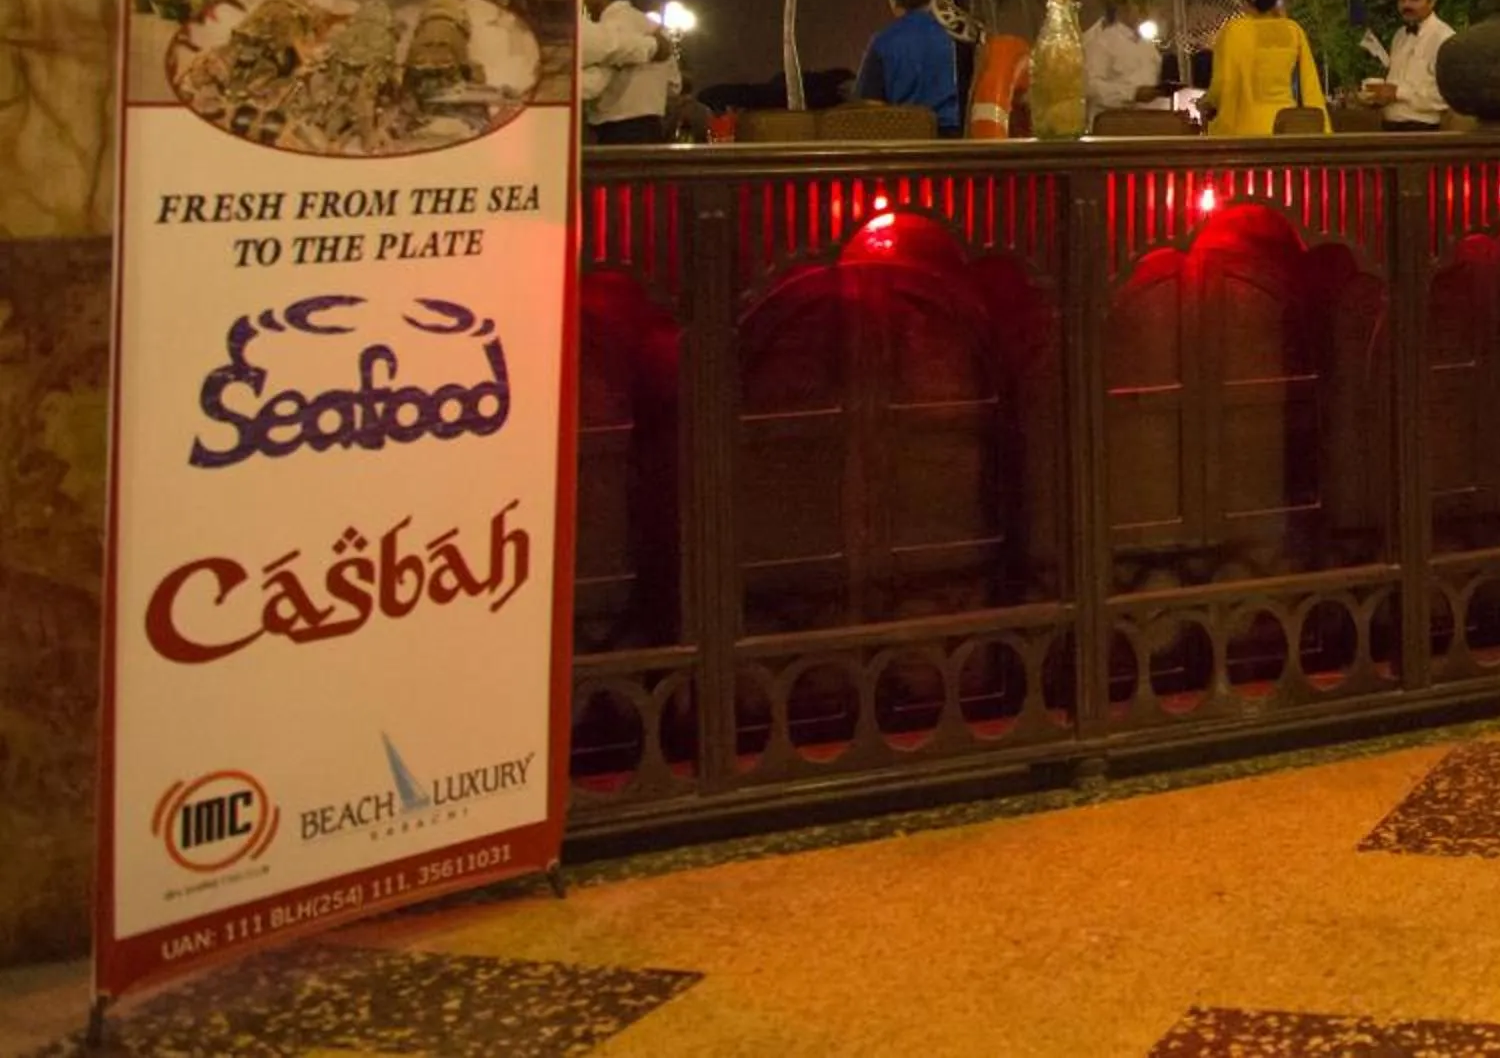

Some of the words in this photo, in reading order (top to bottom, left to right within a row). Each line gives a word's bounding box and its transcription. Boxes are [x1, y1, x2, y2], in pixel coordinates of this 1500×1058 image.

[156, 192, 286, 224] FRESH
[298, 188, 399, 220] FROM
[409, 186, 479, 216] THE
[487, 184, 542, 213] SEA
[233, 236, 284, 268] TO
[291, 233, 366, 264] THE
[374, 228, 485, 260] PLATE
[188, 316, 510, 469] Seafood
[181, 790, 253, 850] IMC
[299, 791, 395, 842] BEACH
[432, 751, 536, 807] LUXURY
[161, 927, 217, 961] UAN:
[225, 914, 263, 943] 111
[417, 843, 512, 886] 35611031
